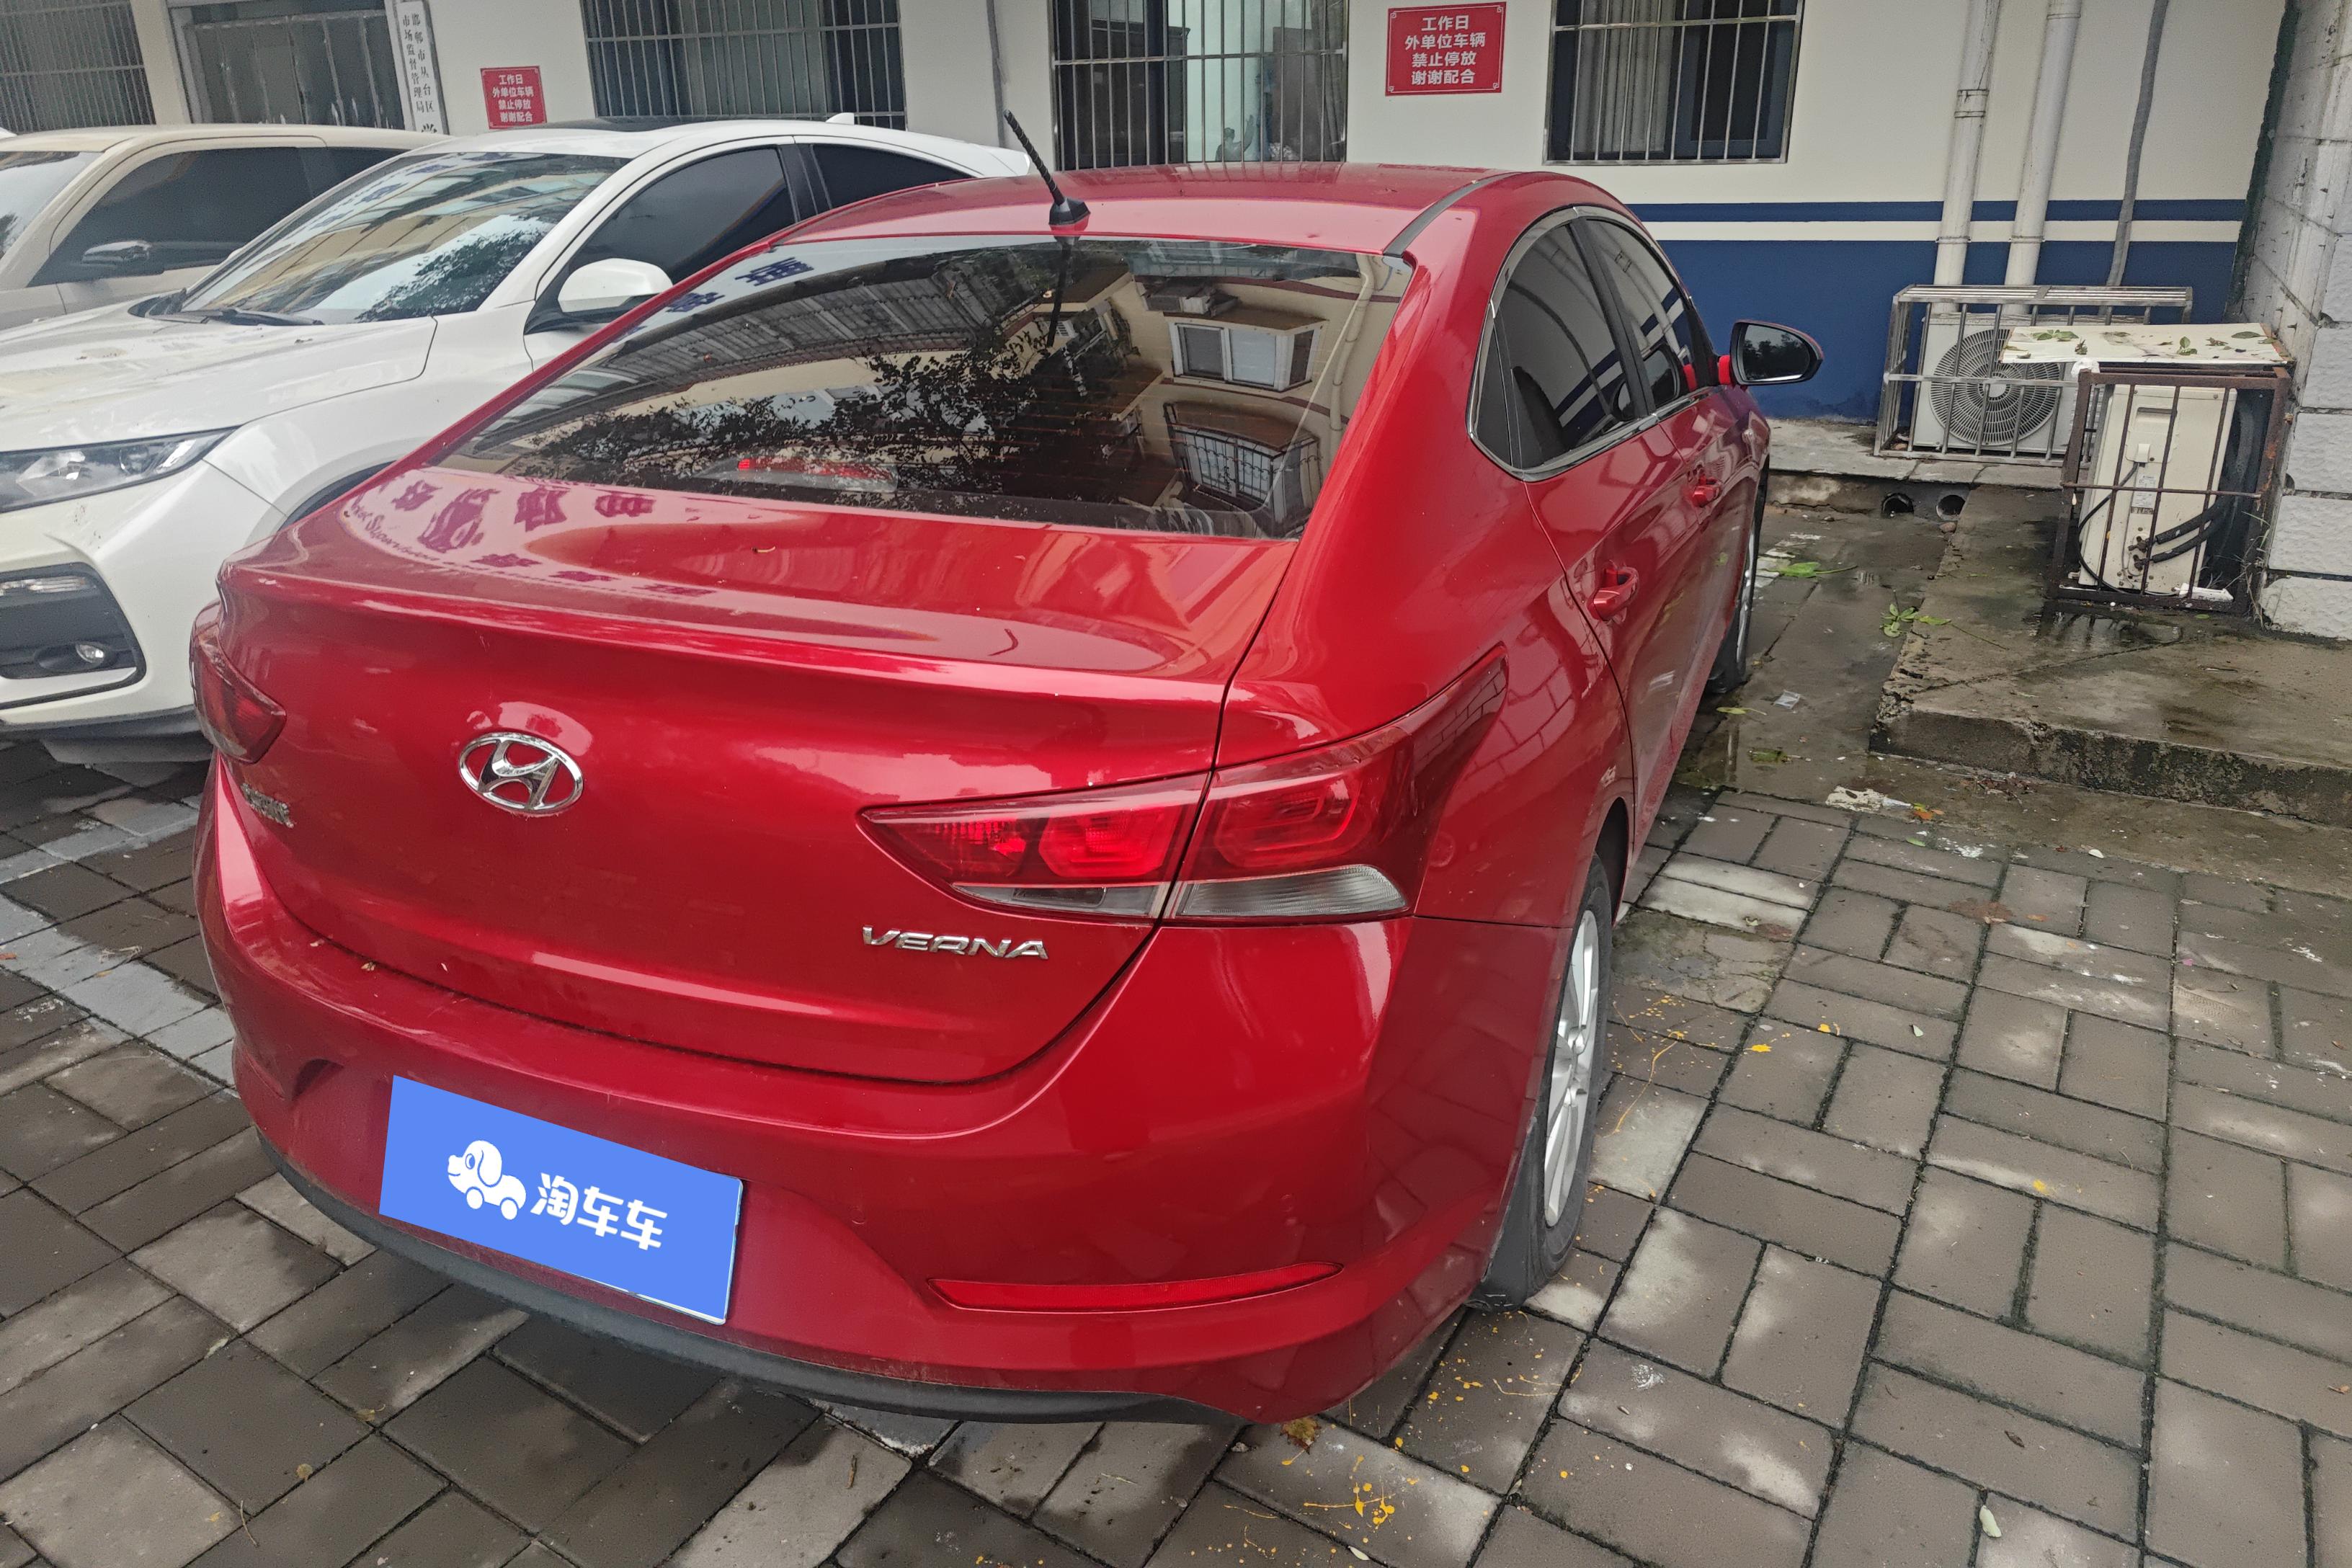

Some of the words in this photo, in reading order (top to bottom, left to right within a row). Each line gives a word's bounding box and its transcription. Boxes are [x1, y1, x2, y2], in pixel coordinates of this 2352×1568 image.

[1421, 14, 1469, 31] 工作日
[1405, 32, 1487, 50] 外单位车辆
[1412, 50, 1477, 68] 禁止停放
[499, 74, 522, 85] 工作日
[1411, 68, 1476, 85] 谢谢配合
[492, 86, 535, 98] 外单位车辆
[498, 99, 532, 110] 禁止停放
[500, 112, 533, 123] 谢谢配合
[863, 925, 1049, 960] VERNA
